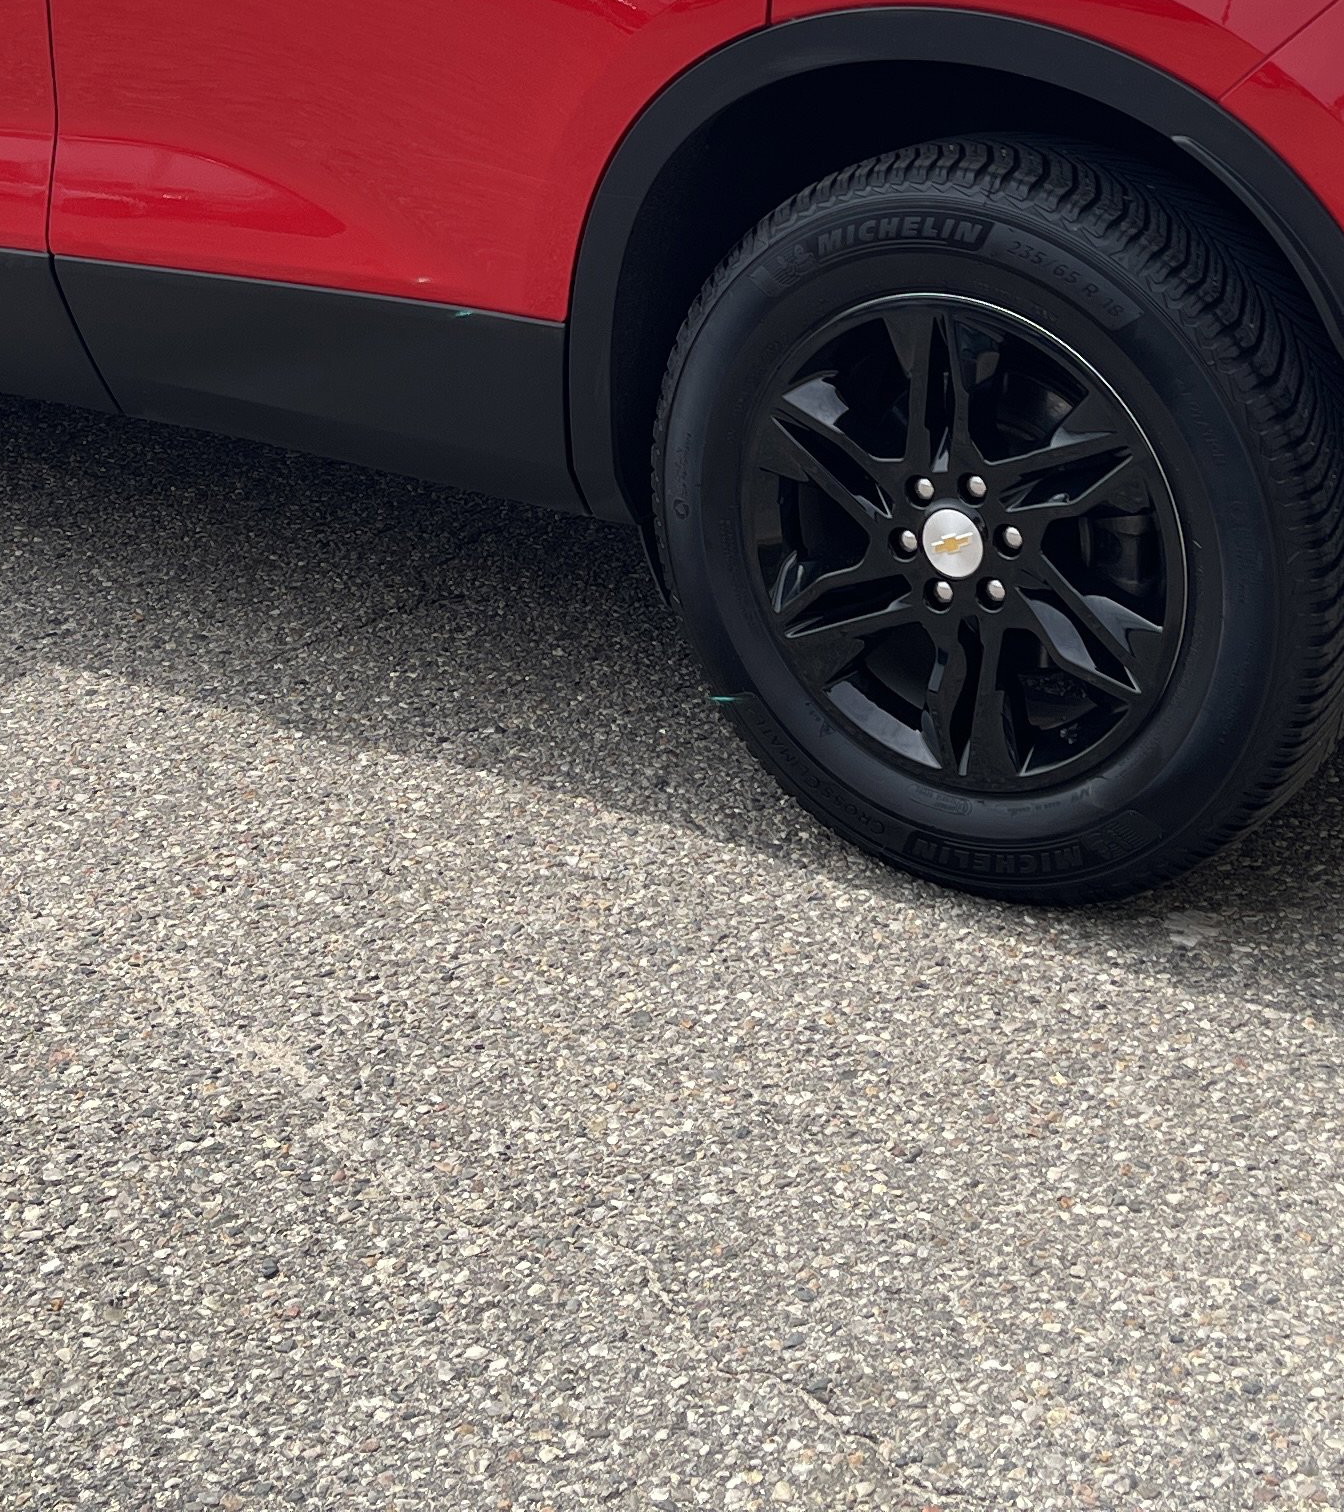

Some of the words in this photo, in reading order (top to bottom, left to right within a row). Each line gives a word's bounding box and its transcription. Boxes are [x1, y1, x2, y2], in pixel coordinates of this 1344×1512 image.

[818, 216, 984, 257] MICHELIN
[1006, 240, 1081, 284] 235/65
[1082, 283, 1099, 298] R
[1102, 298, 1126, 318] 18
[911, 837, 1084, 875] MICHELIN
